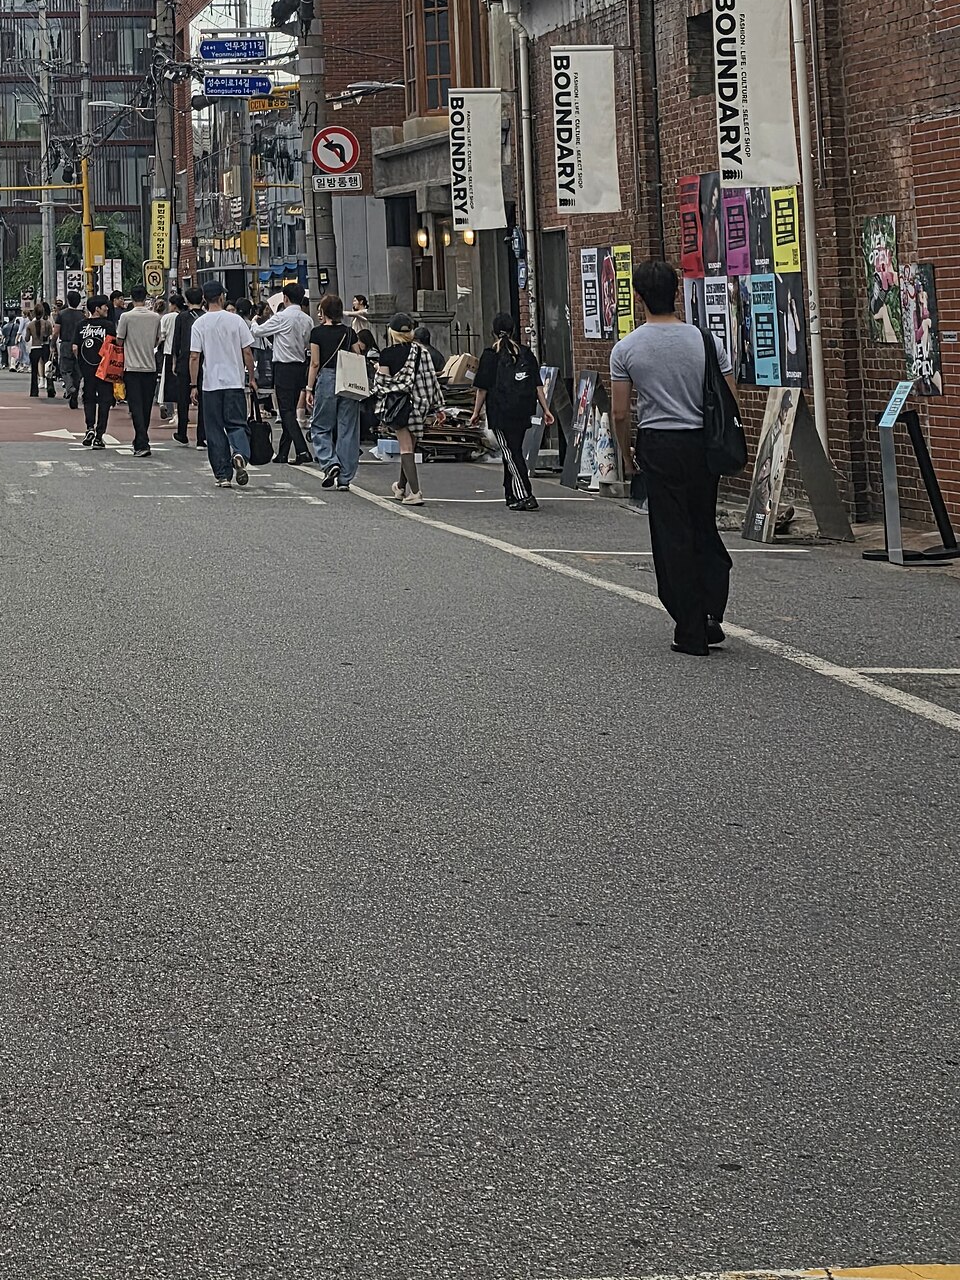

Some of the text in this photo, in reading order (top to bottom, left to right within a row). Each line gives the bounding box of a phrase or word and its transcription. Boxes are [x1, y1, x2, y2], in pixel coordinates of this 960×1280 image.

[224, 41, 265, 51] 연무장11길
[250, 100, 266, 110] CCTV
[553, 55, 576, 195] BOUNDARY
[742, 108, 750, 136] SELECT
[450, 96, 469, 215] BOUNDARY
[744, 137, 752, 158] SHOP
[316, 176, 358, 189] 일방통행
